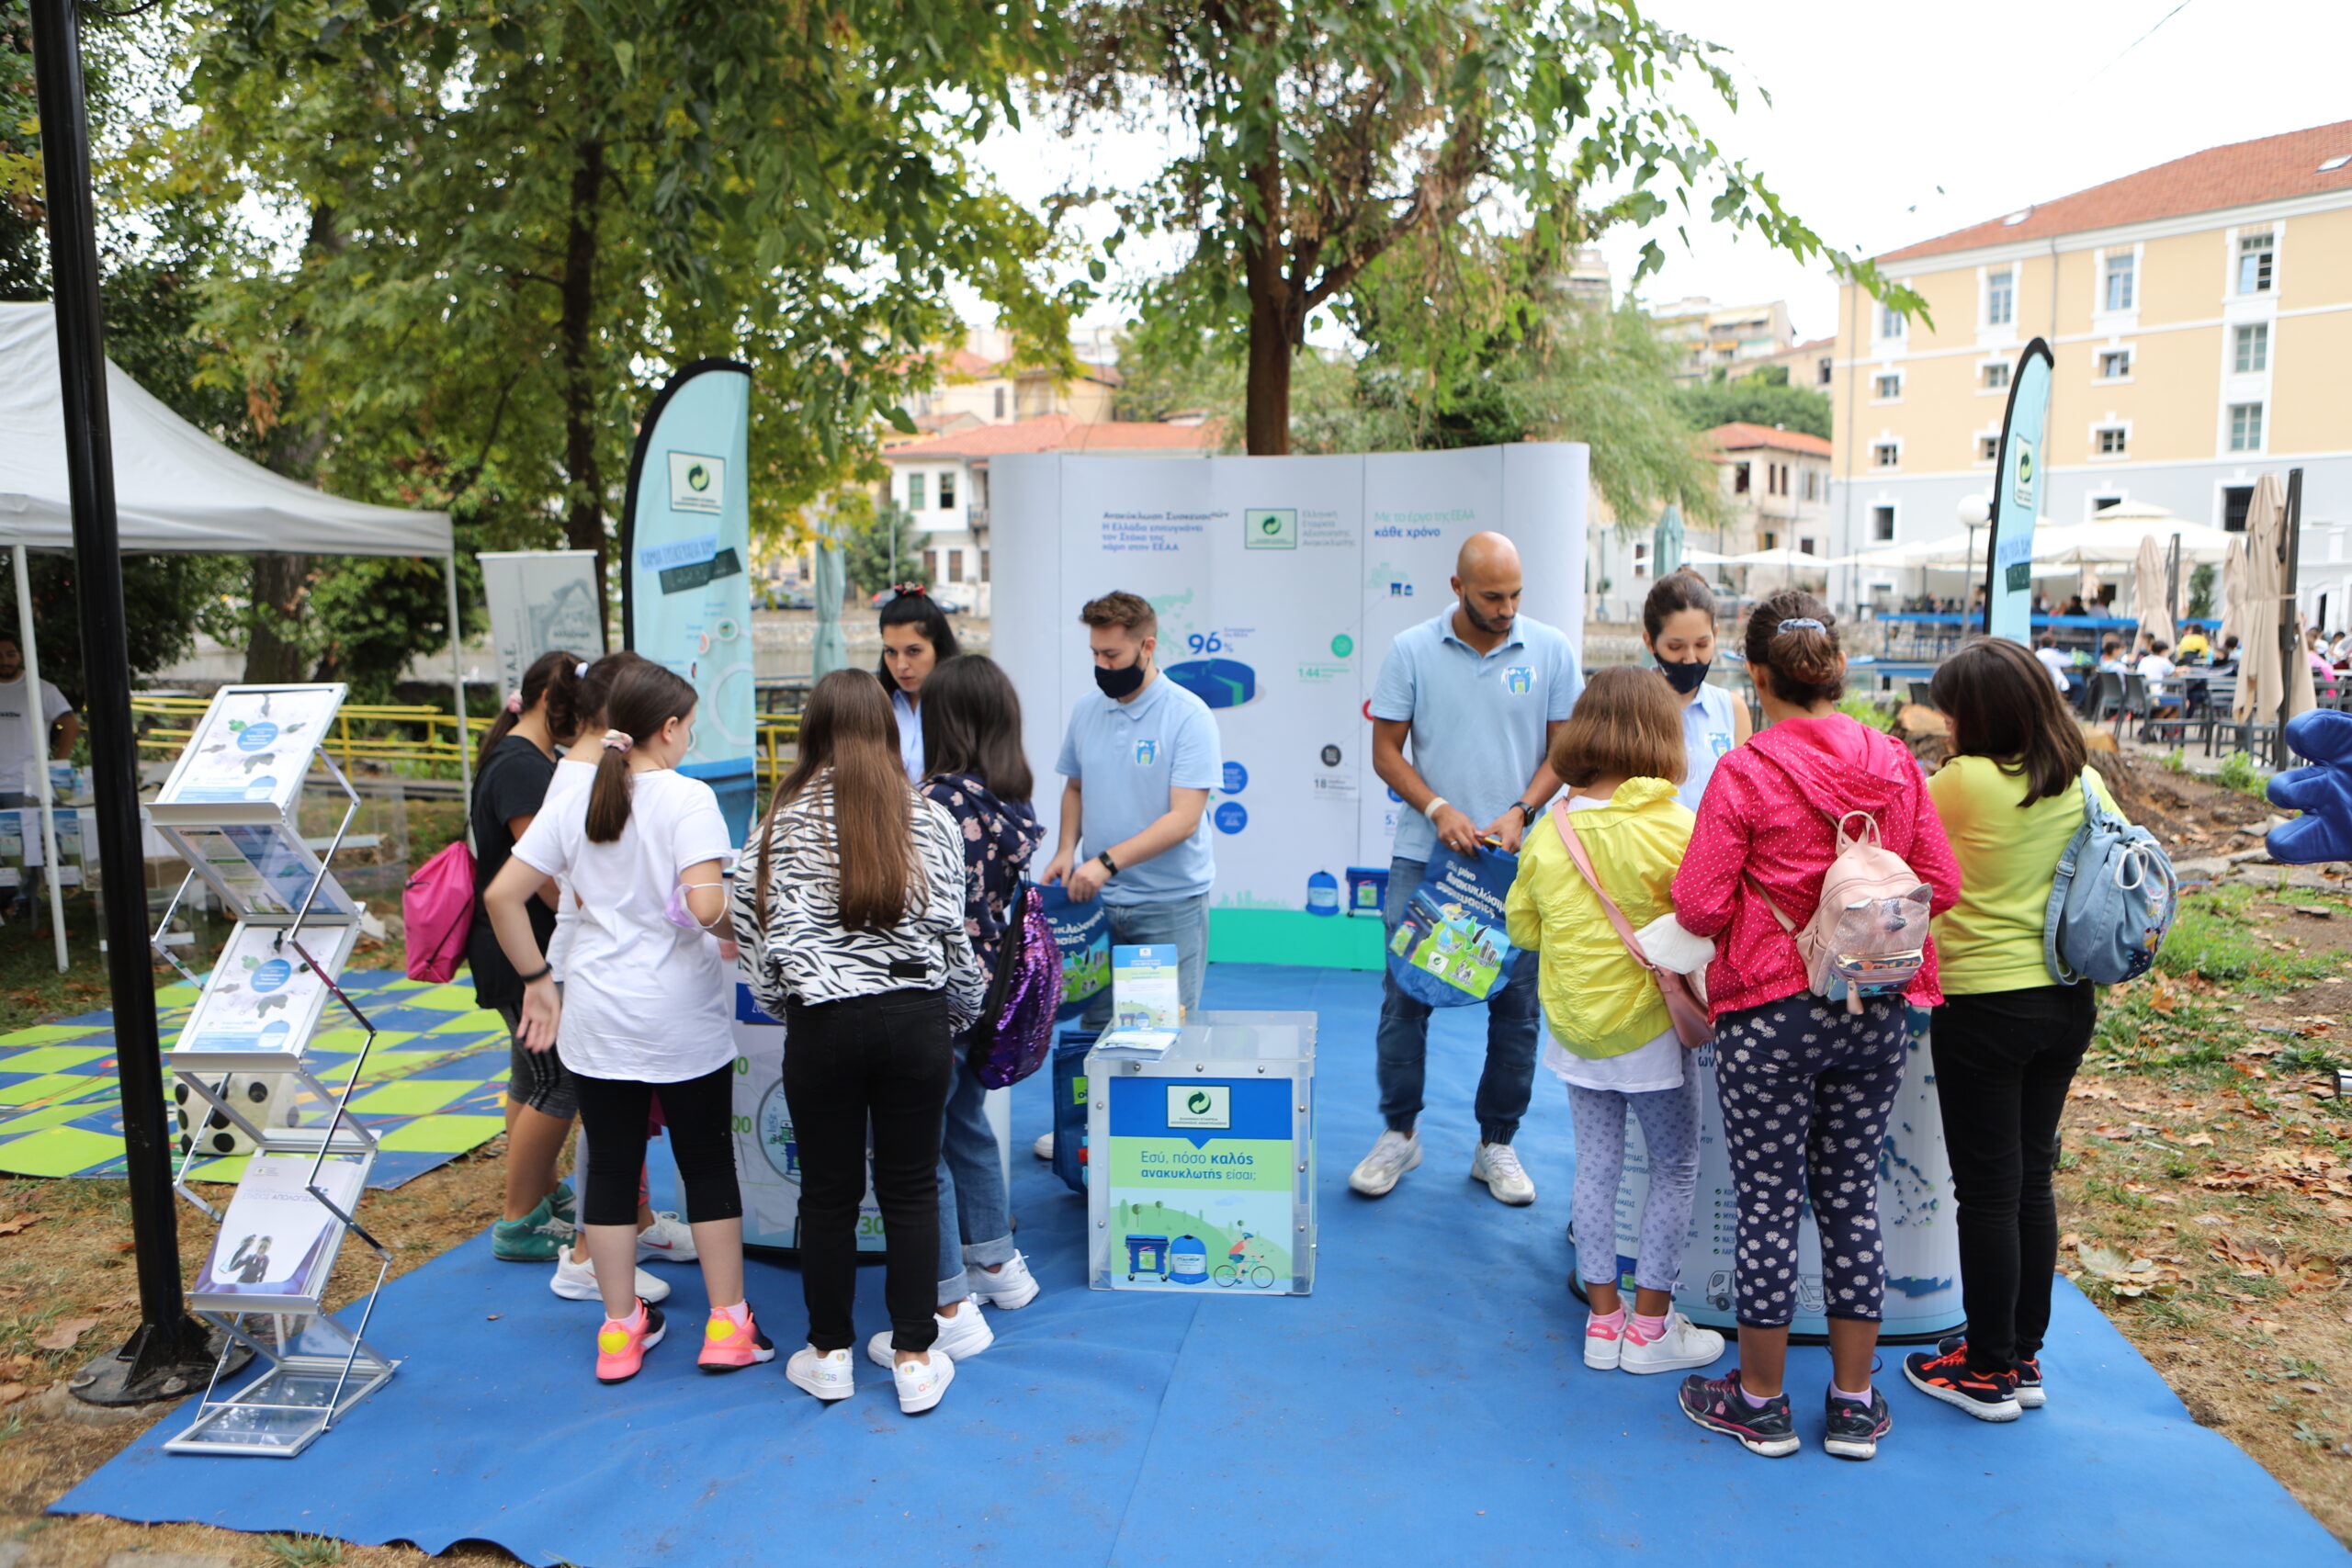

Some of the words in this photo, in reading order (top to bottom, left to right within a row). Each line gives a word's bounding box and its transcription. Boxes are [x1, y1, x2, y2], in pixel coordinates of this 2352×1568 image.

[1374, 525, 1403, 537] κάθε
[1406, 526, 1441, 539] χρόνο
[1188, 632, 1222, 655] 96
[1140, 1150, 1170, 1165] Εσύ,
[1172, 1150, 1207, 1165] πόσο
[1210, 1152, 1254, 1165] καλός
[1141, 1168, 1223, 1179] ανακυκλωτής
[1225, 1169, 1257, 1181] είσαι;
